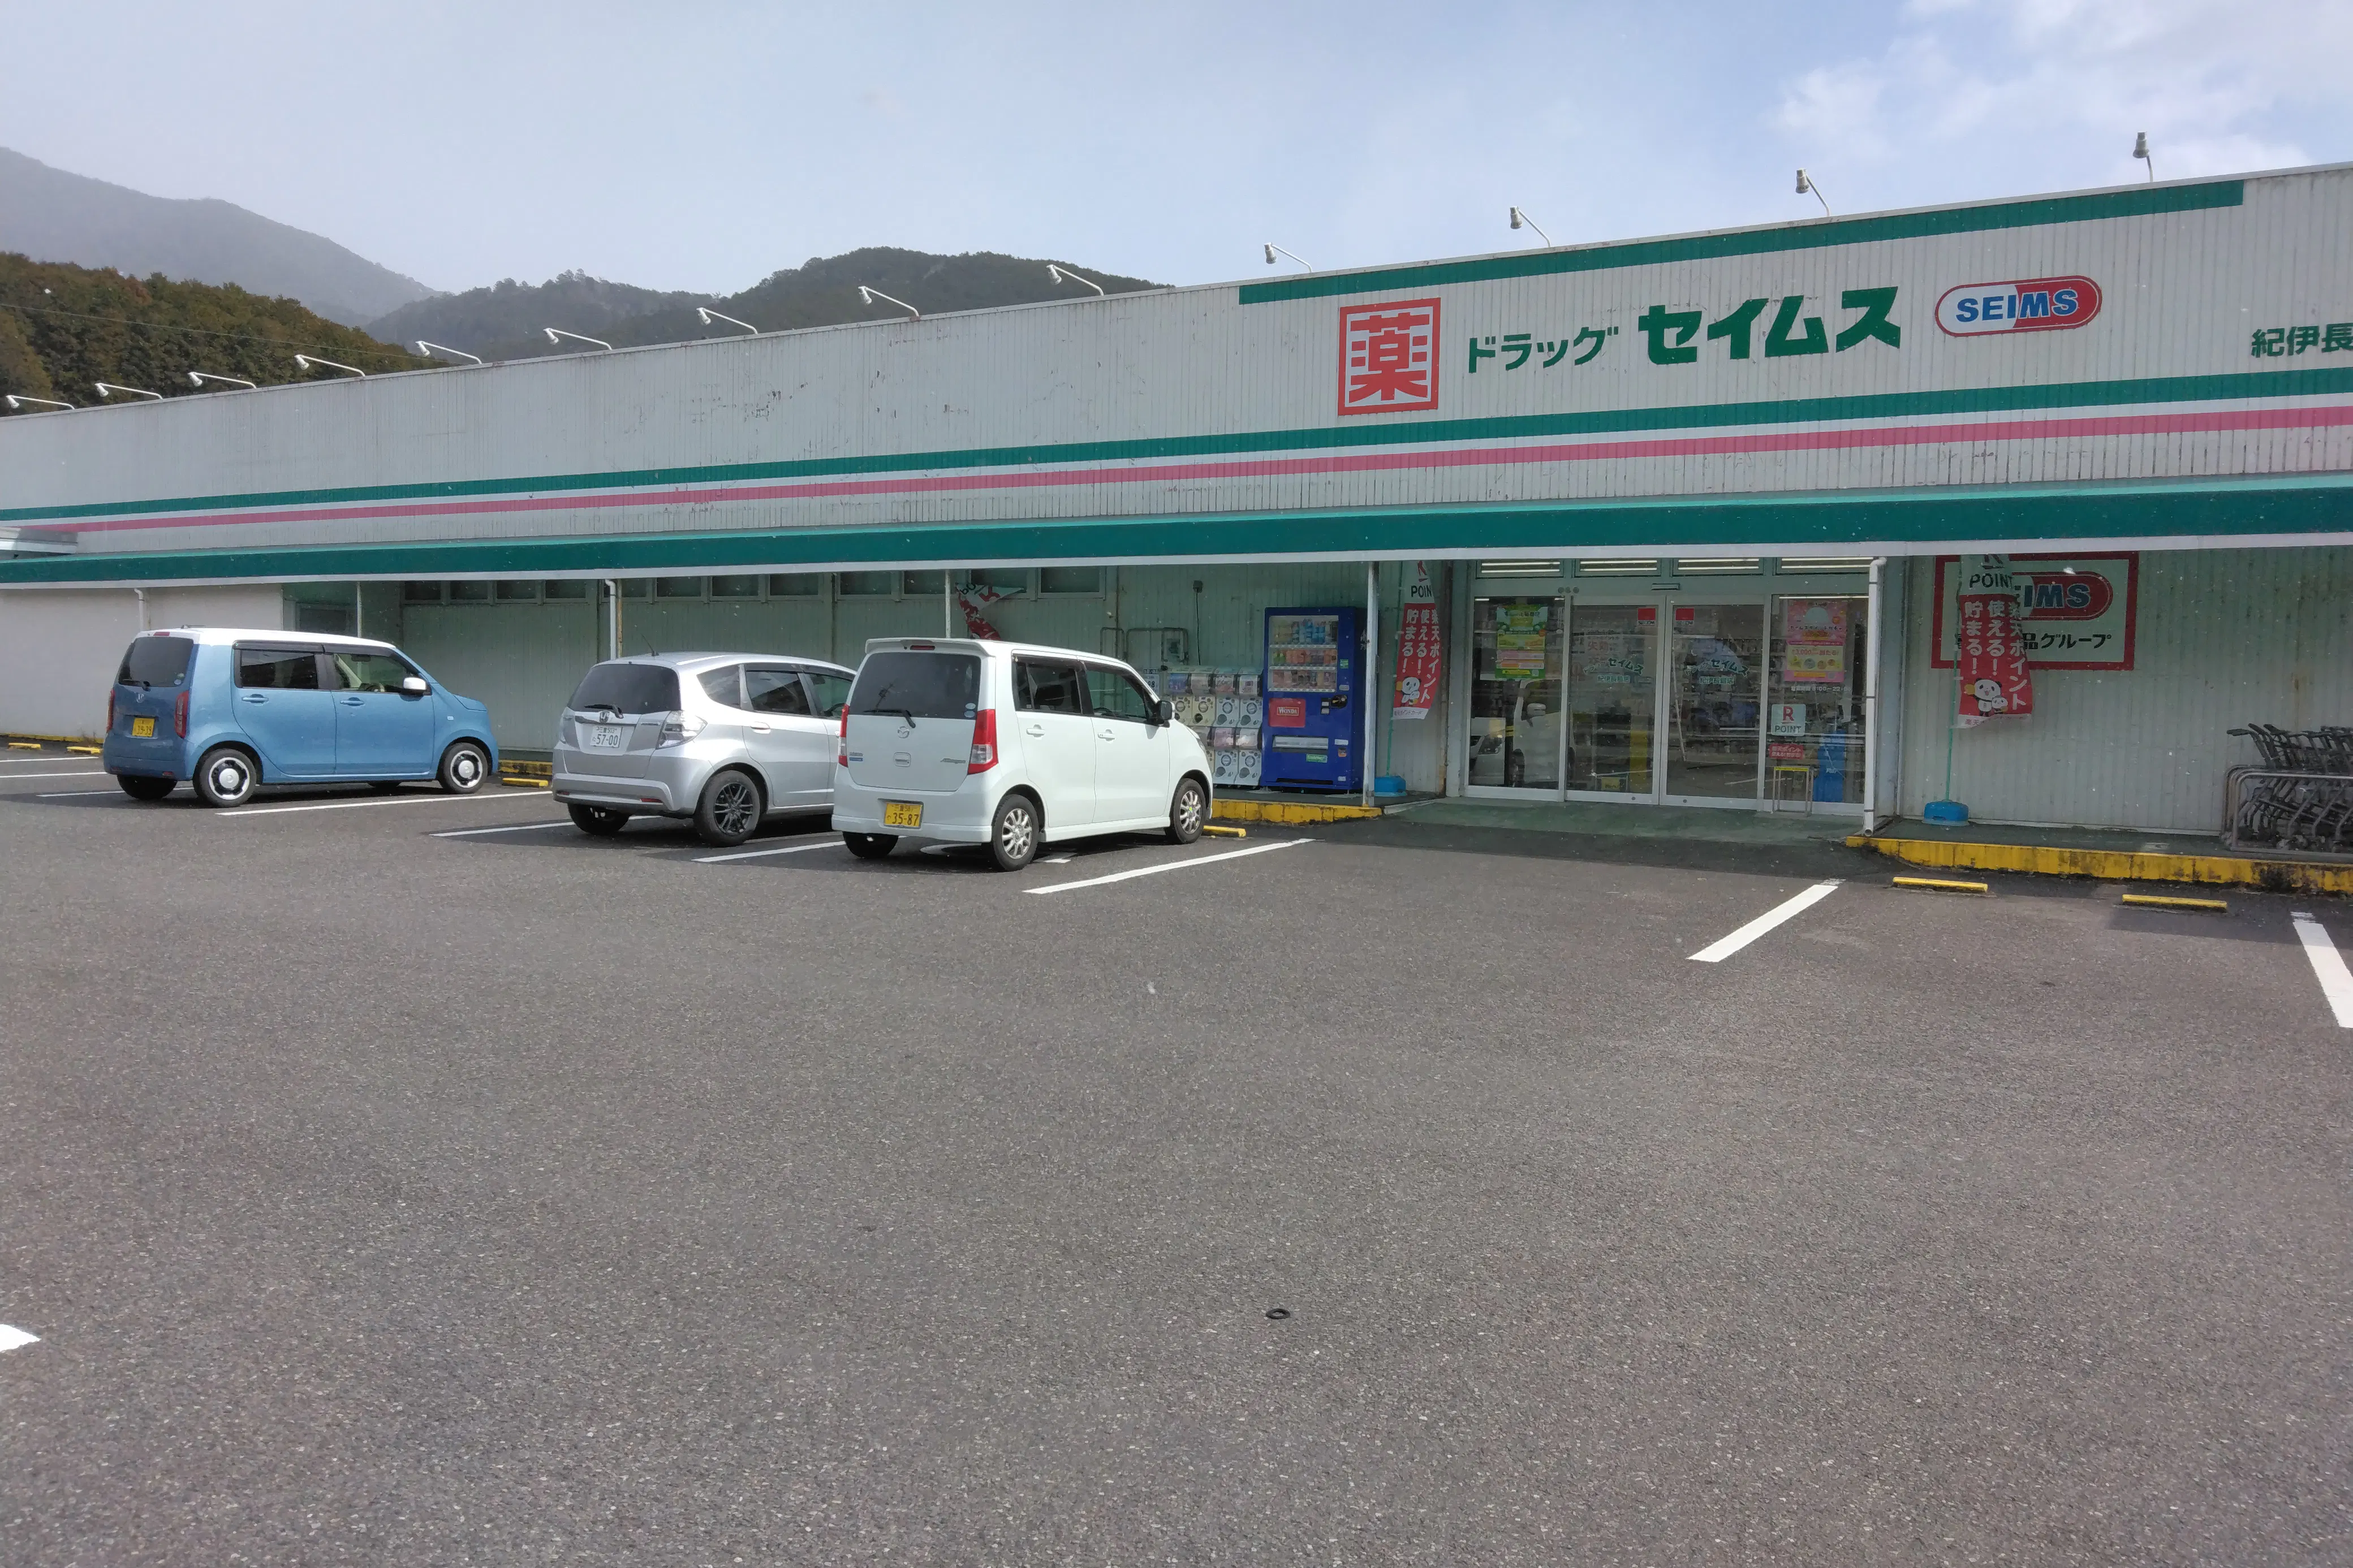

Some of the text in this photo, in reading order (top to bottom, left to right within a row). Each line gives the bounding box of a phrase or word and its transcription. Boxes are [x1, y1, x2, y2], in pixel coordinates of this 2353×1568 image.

[1955, 288, 2080, 323] SEIMS
[1468, 286, 1902, 374] ドラッグ セイムス
[2251, 322, 2353, 358] 紀伊長
[1349, 312, 1430, 403] 薬
[2015, 584, 2091, 608] IMS
[1782, 706, 1795, 722] R
[596, 733, 619, 746] 57-00
[892, 812, 919, 826] 35-87
